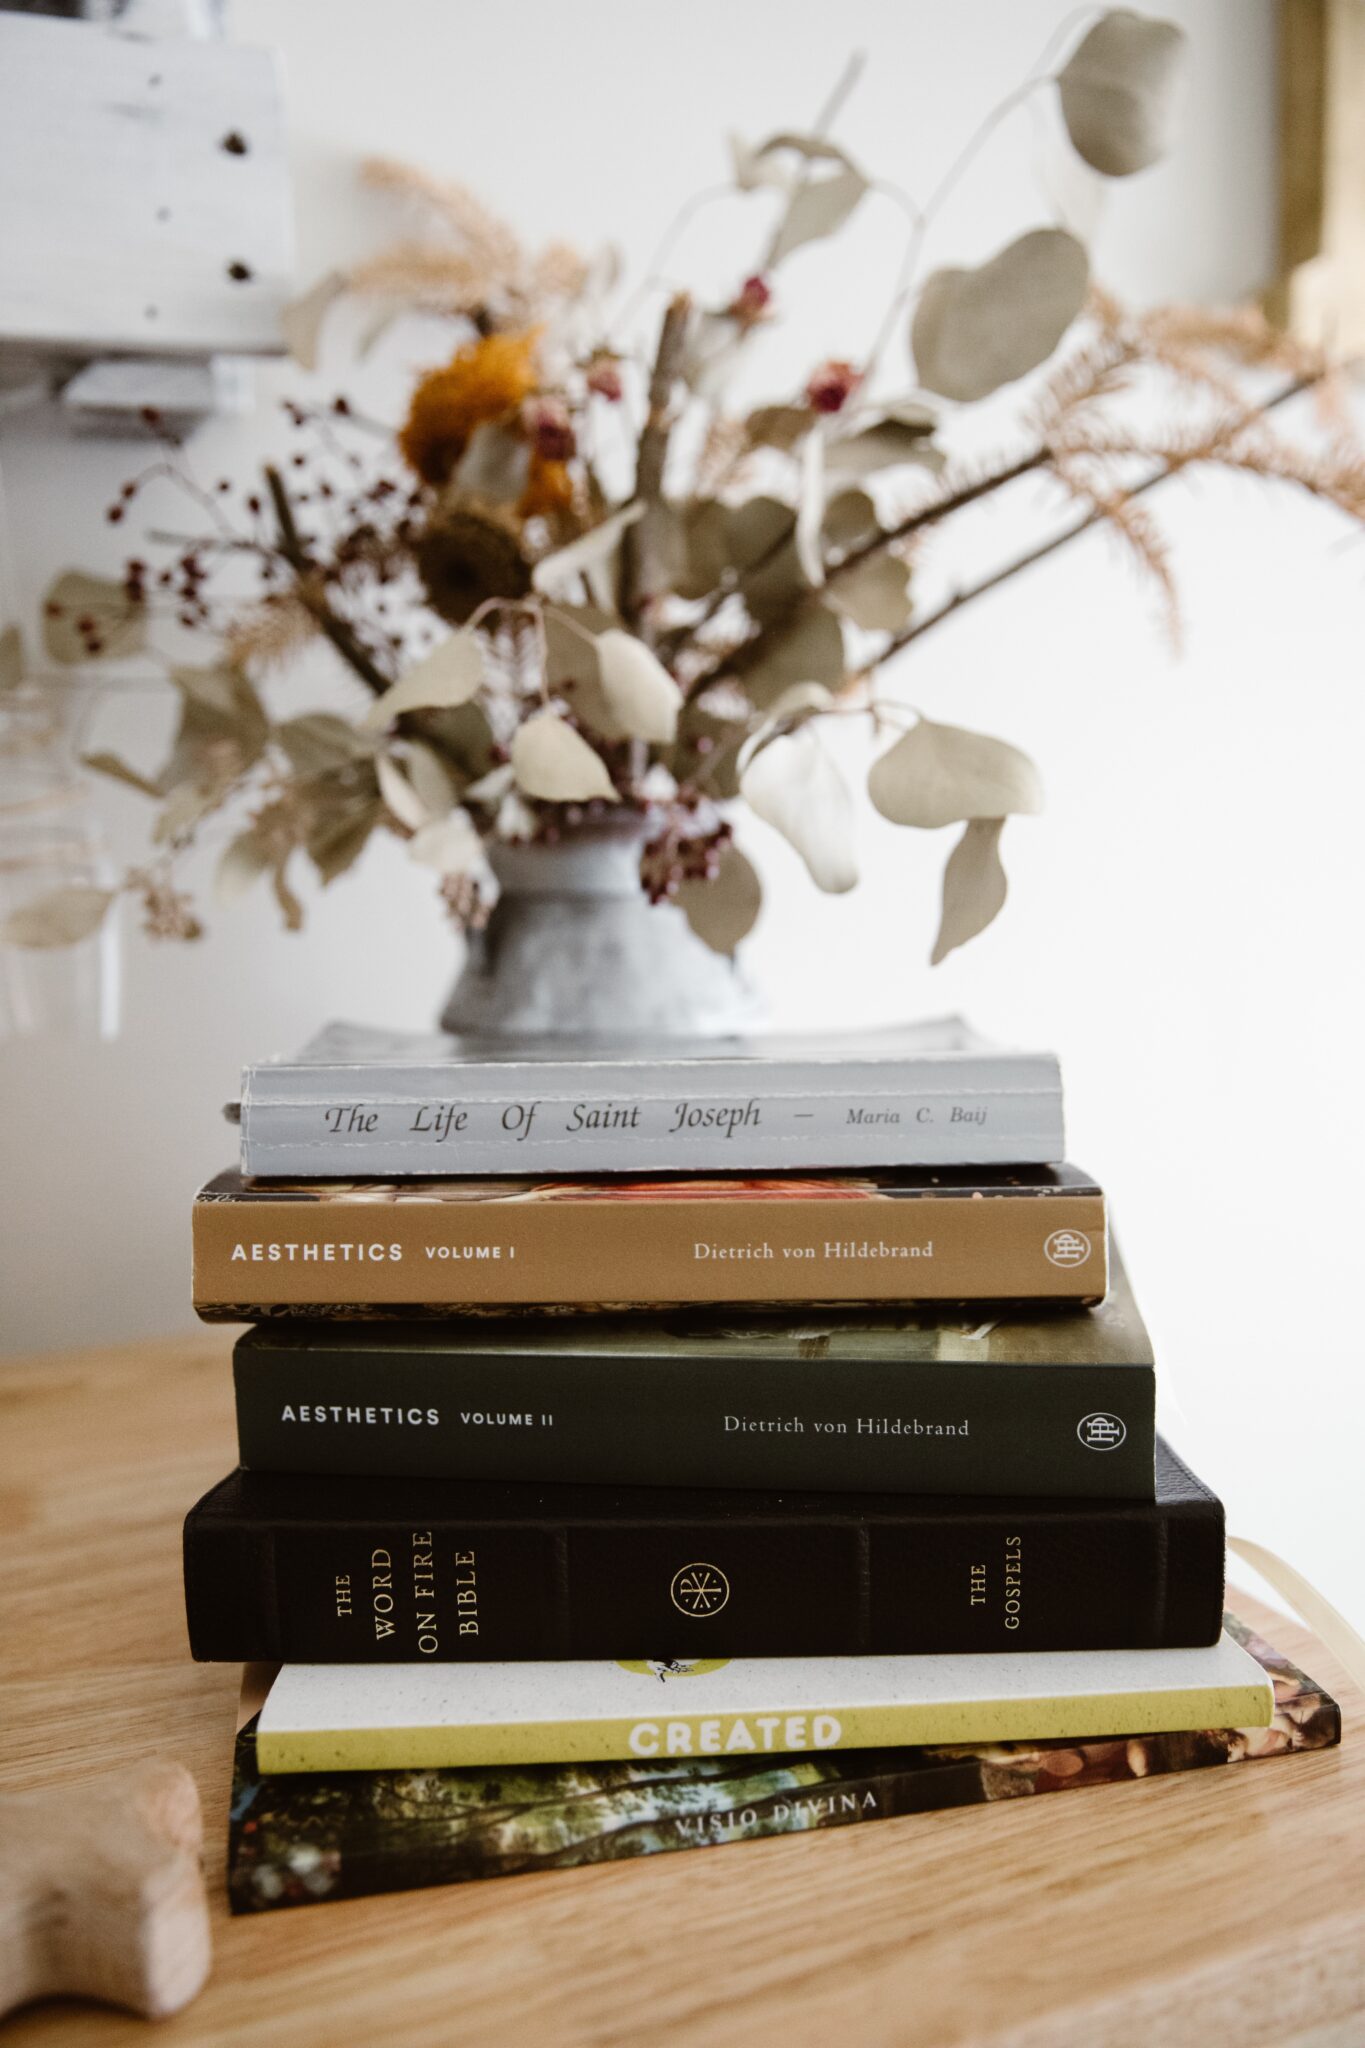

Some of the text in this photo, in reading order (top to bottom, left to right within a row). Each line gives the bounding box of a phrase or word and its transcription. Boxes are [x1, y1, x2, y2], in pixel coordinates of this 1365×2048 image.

[325, 1104, 378, 1133] The
[409, 1104, 468, 1142] Life
[502, 1101, 540, 1140] Of
[566, 1103, 642, 1132] Saint
[669, 1099, 763, 1138] Joseph
[846, 1107, 900, 1125] Maria
[916, 1107, 934, 1124] C.
[949, 1106, 989, 1126] Baij
[231, 1243, 515, 1262] AESTHETICS VOLUME I
[694, 1241, 934, 1260] Dietrich von Hildebrand
[281, 1405, 553, 1426] AESTHETICS VOLUME II
[724, 1416, 970, 1437] Dietrich von Hildebrand
[335, 1575, 352, 1617] THE
[372, 1548, 395, 1640] WORD
[413, 1531, 438, 1654] ON FIRE
[455, 1550, 479, 1636] BIBLE
[970, 1564, 986, 1606] THE
[1004, 1536, 1022, 1630] GOSPELS
[629, 1715, 842, 1755] CREATED
[675, 1791, 877, 1837] VISIO DIVINA
